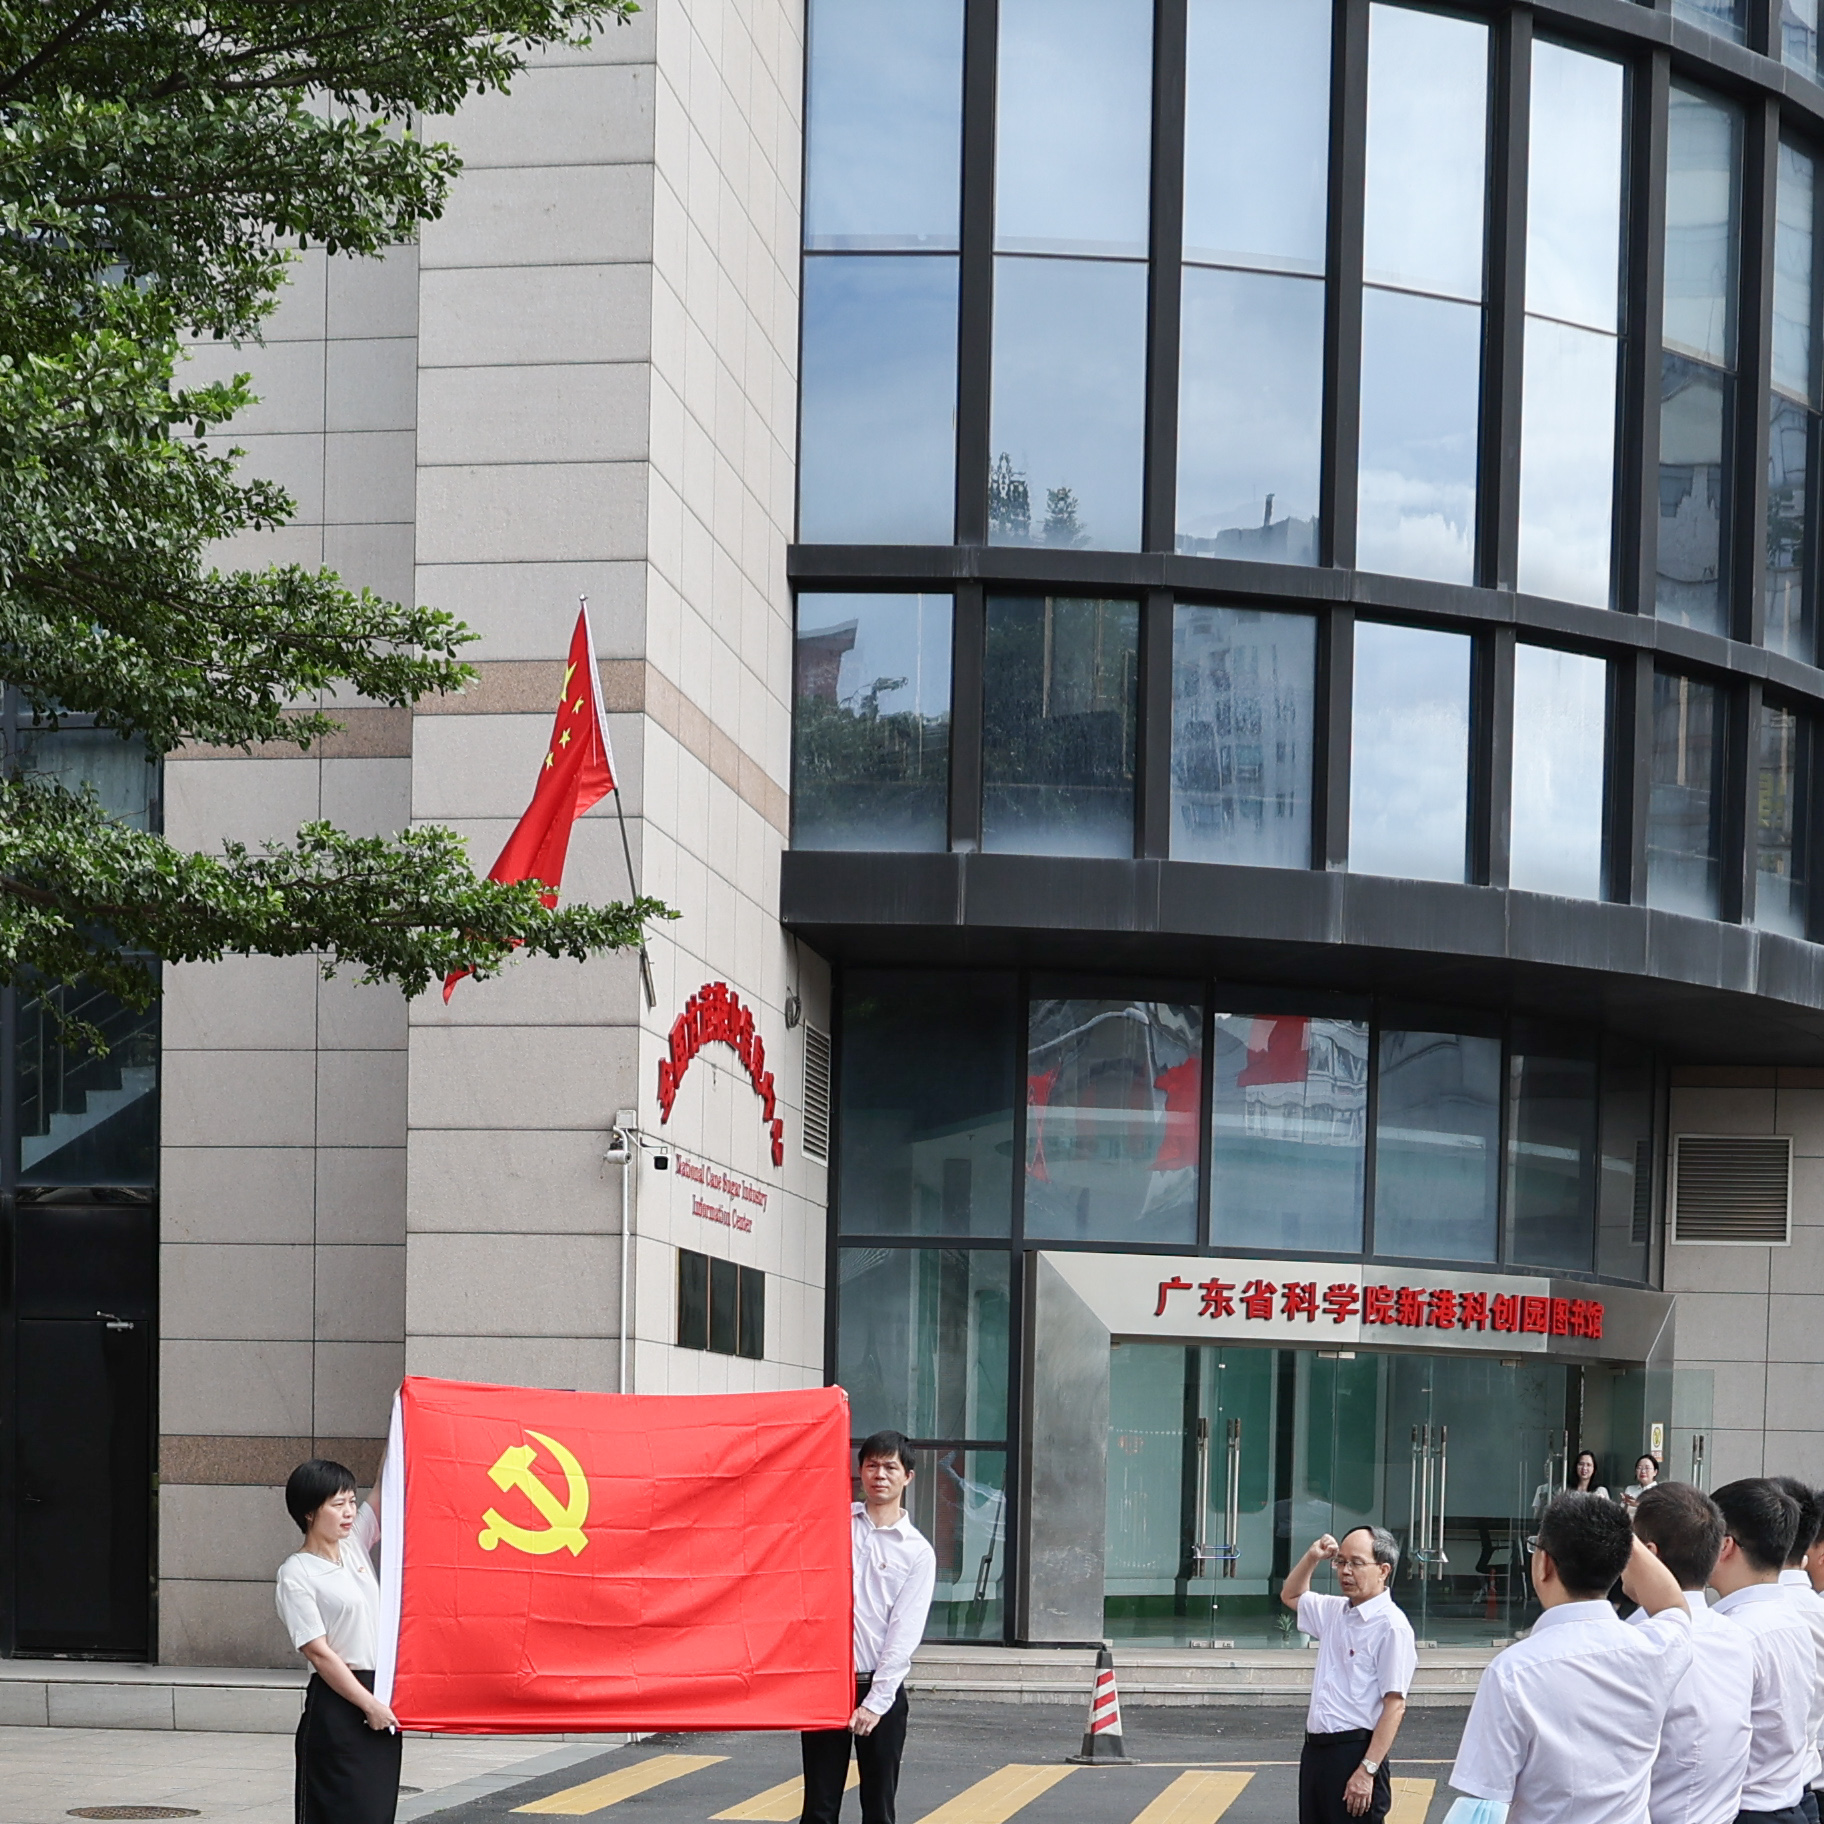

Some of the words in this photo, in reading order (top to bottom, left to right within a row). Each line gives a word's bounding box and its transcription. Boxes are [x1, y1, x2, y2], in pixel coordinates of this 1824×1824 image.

[675, 1154, 705, 1184] National
[706, 1166, 722, 1190] Cane
[722, 1172, 741, 1201] Sugar
[741, 1180, 767, 1213] Industry
[692, 1194, 731, 1226] Information
[732, 1208, 752, 1233] Center
[1154, 1276, 1605, 1339] 广东省科学院新港科创园图书馆
